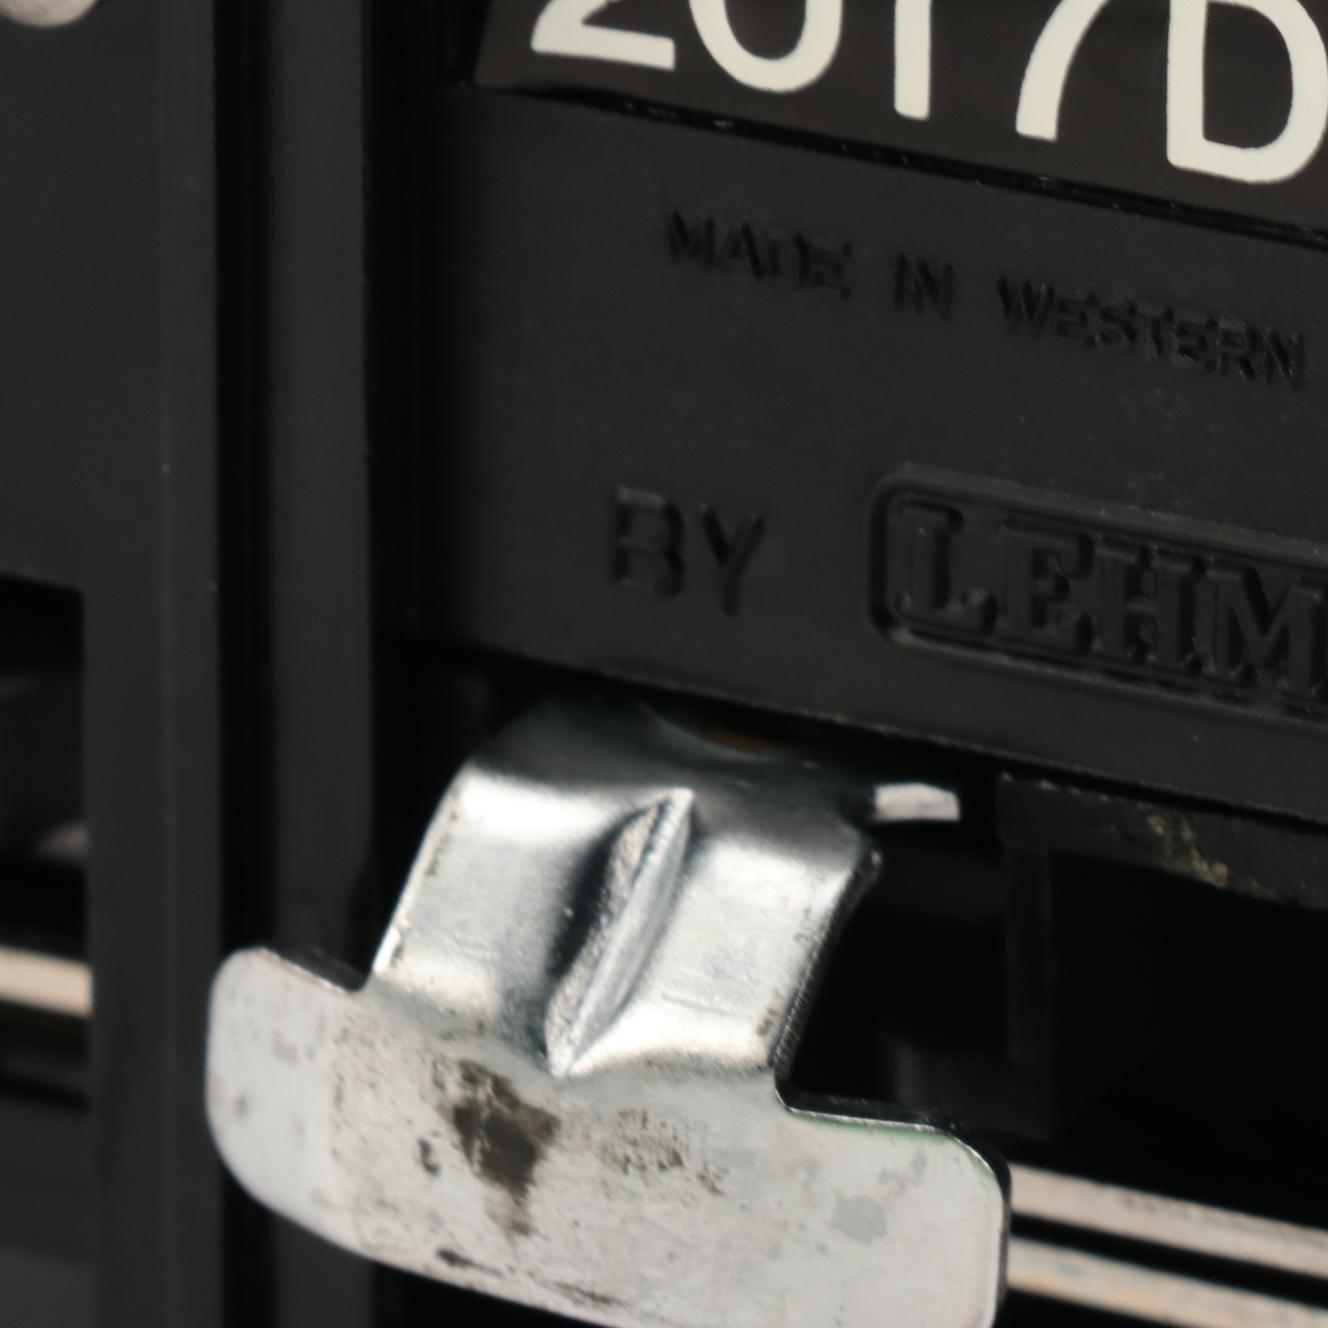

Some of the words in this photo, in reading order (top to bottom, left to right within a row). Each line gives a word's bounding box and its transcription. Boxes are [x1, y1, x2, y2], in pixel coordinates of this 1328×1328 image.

[666, 208, 853, 299] MADE
[893, 251, 955, 321] IN
[996, 276, 1306, 385] WESTERN
[610, 484, 767, 615] BY
